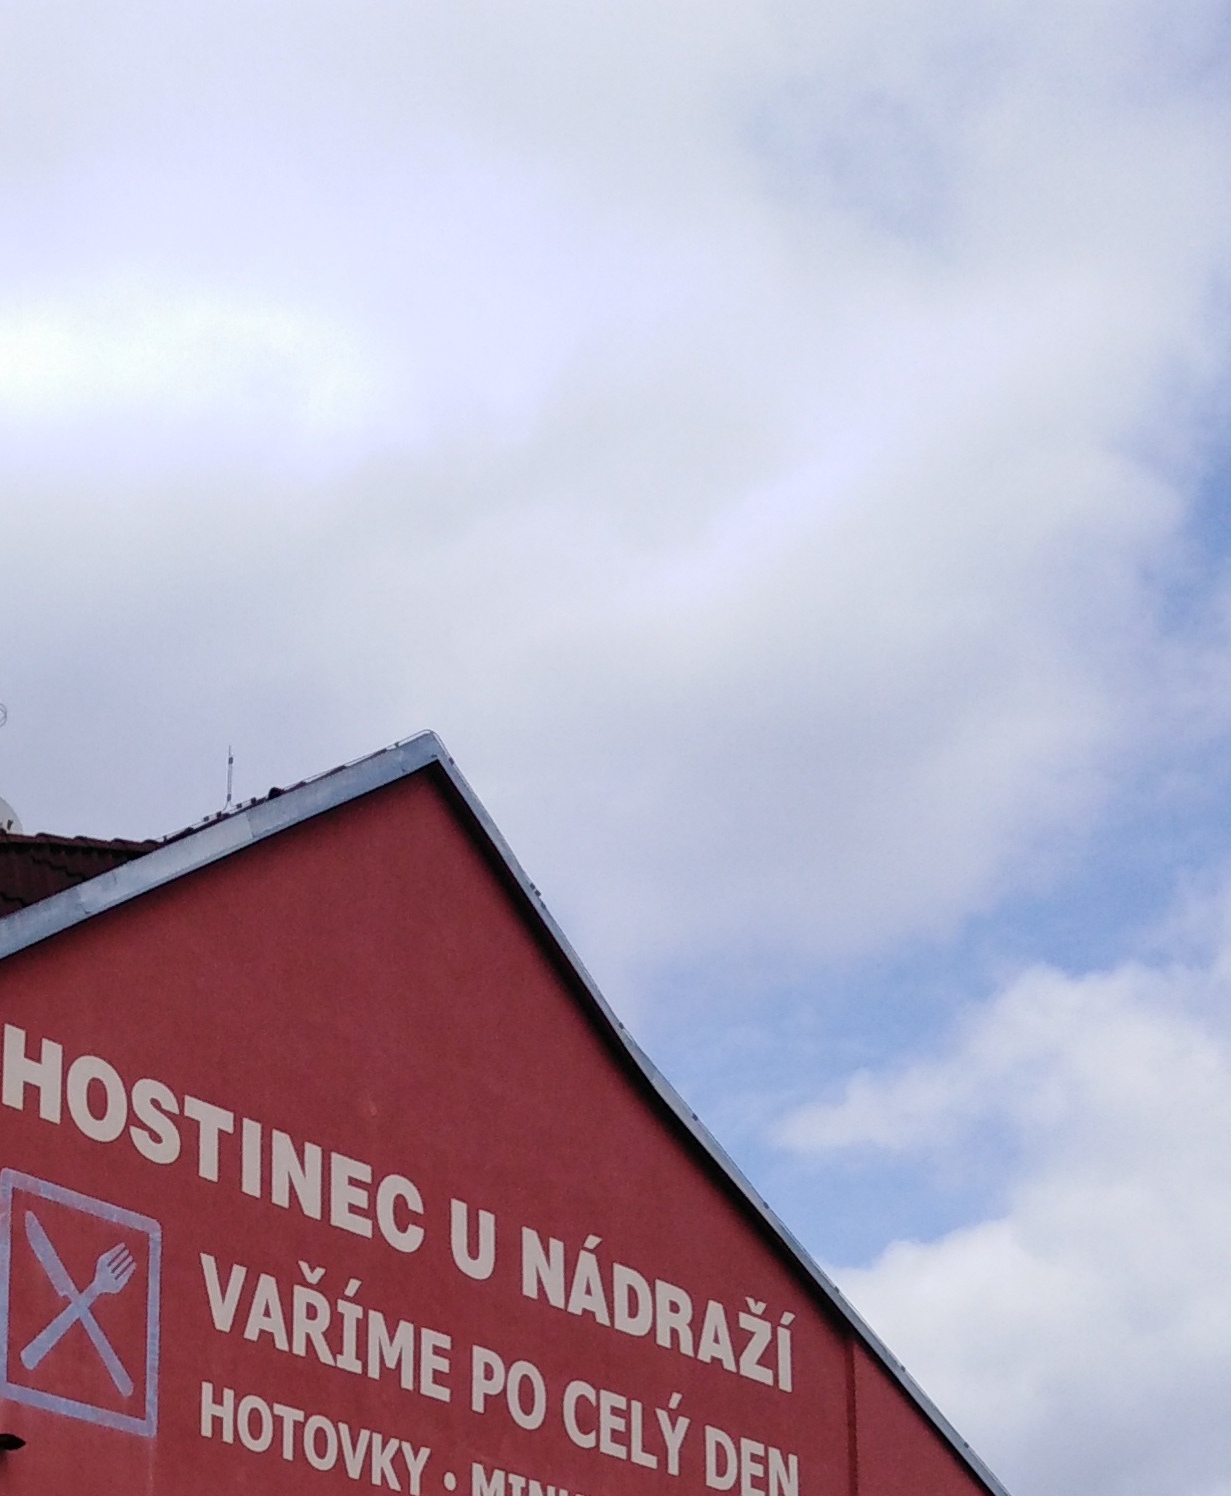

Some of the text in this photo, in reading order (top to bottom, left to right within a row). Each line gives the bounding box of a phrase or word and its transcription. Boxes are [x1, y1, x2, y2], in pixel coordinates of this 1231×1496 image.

[1, 1023, 796, 1393] HOSTINEC U NÁDRAŽÍ
[199, 1252, 453, 1402] VAŘÍME
[471, 1345, 547, 1430] PO
[562, 1380, 691, 1476] CELÝ
[200, 1381, 431, 1496] HOTOVKY
